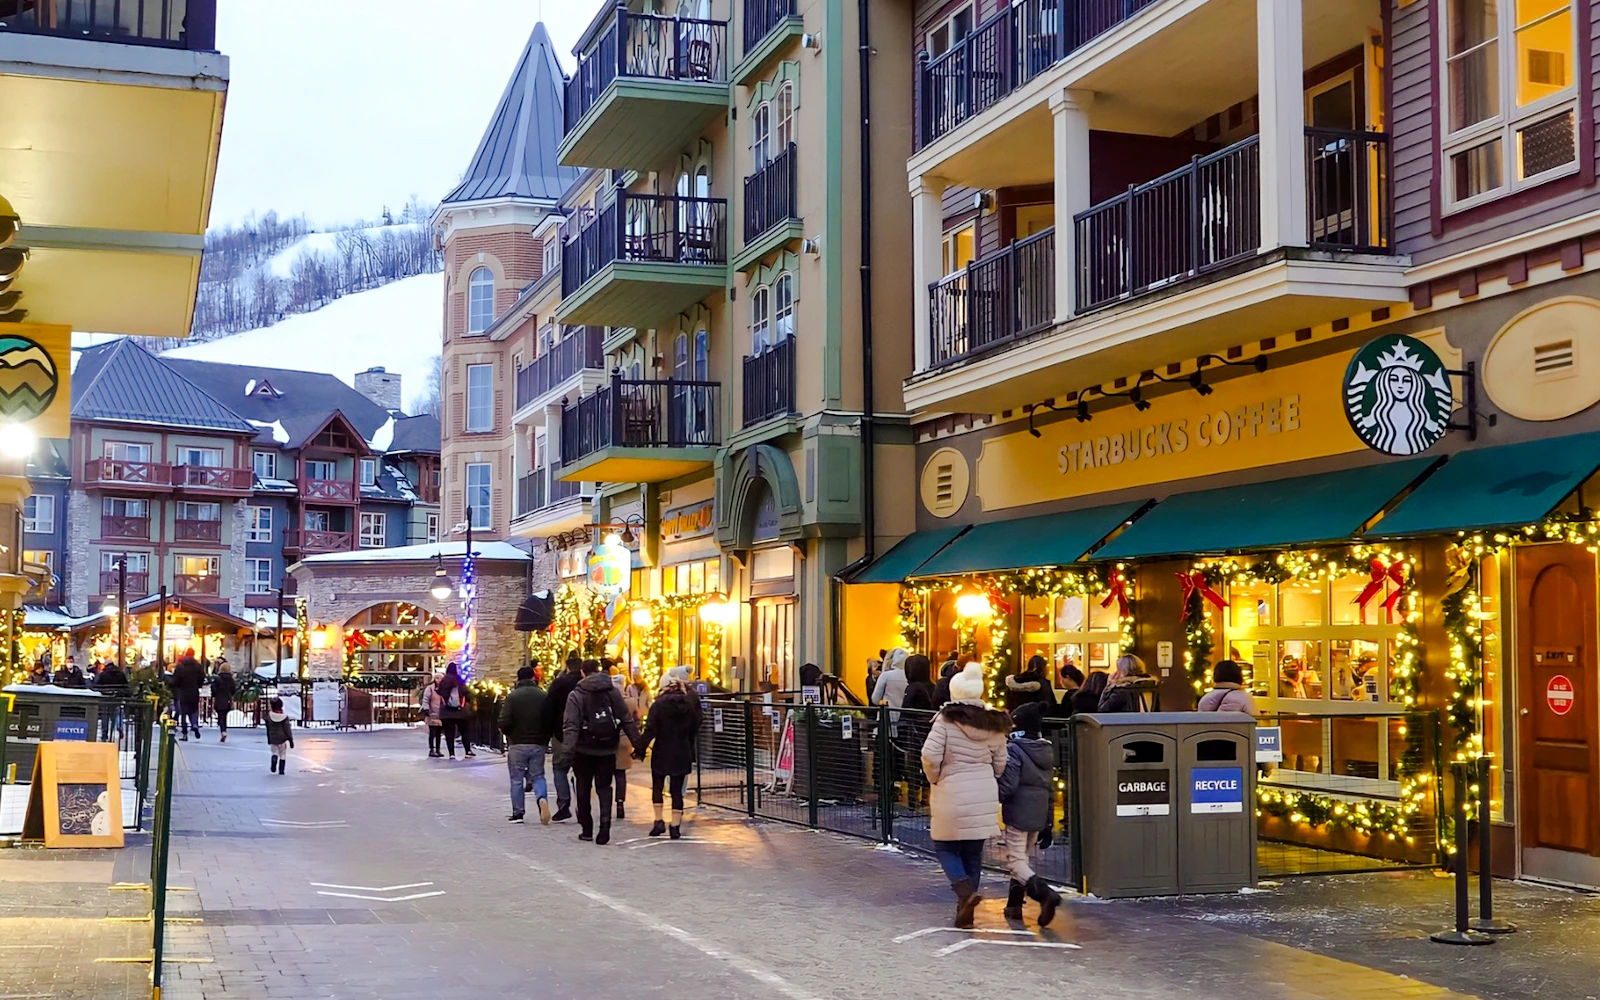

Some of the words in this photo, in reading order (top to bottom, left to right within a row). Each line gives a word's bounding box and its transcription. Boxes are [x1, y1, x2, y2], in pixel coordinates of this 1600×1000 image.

[1058, 419, 1189, 475] STARBUCKS
[1196, 394, 1300, 448] COFFEE
[9, 723, 40, 732] GAAGE
[57, 726, 84, 735] RECYCLE
[1258, 736, 1275, 745] EXIT
[1118, 781, 1167, 793] GARBAGE
[1195, 780, 1238, 791] RECYCLE
